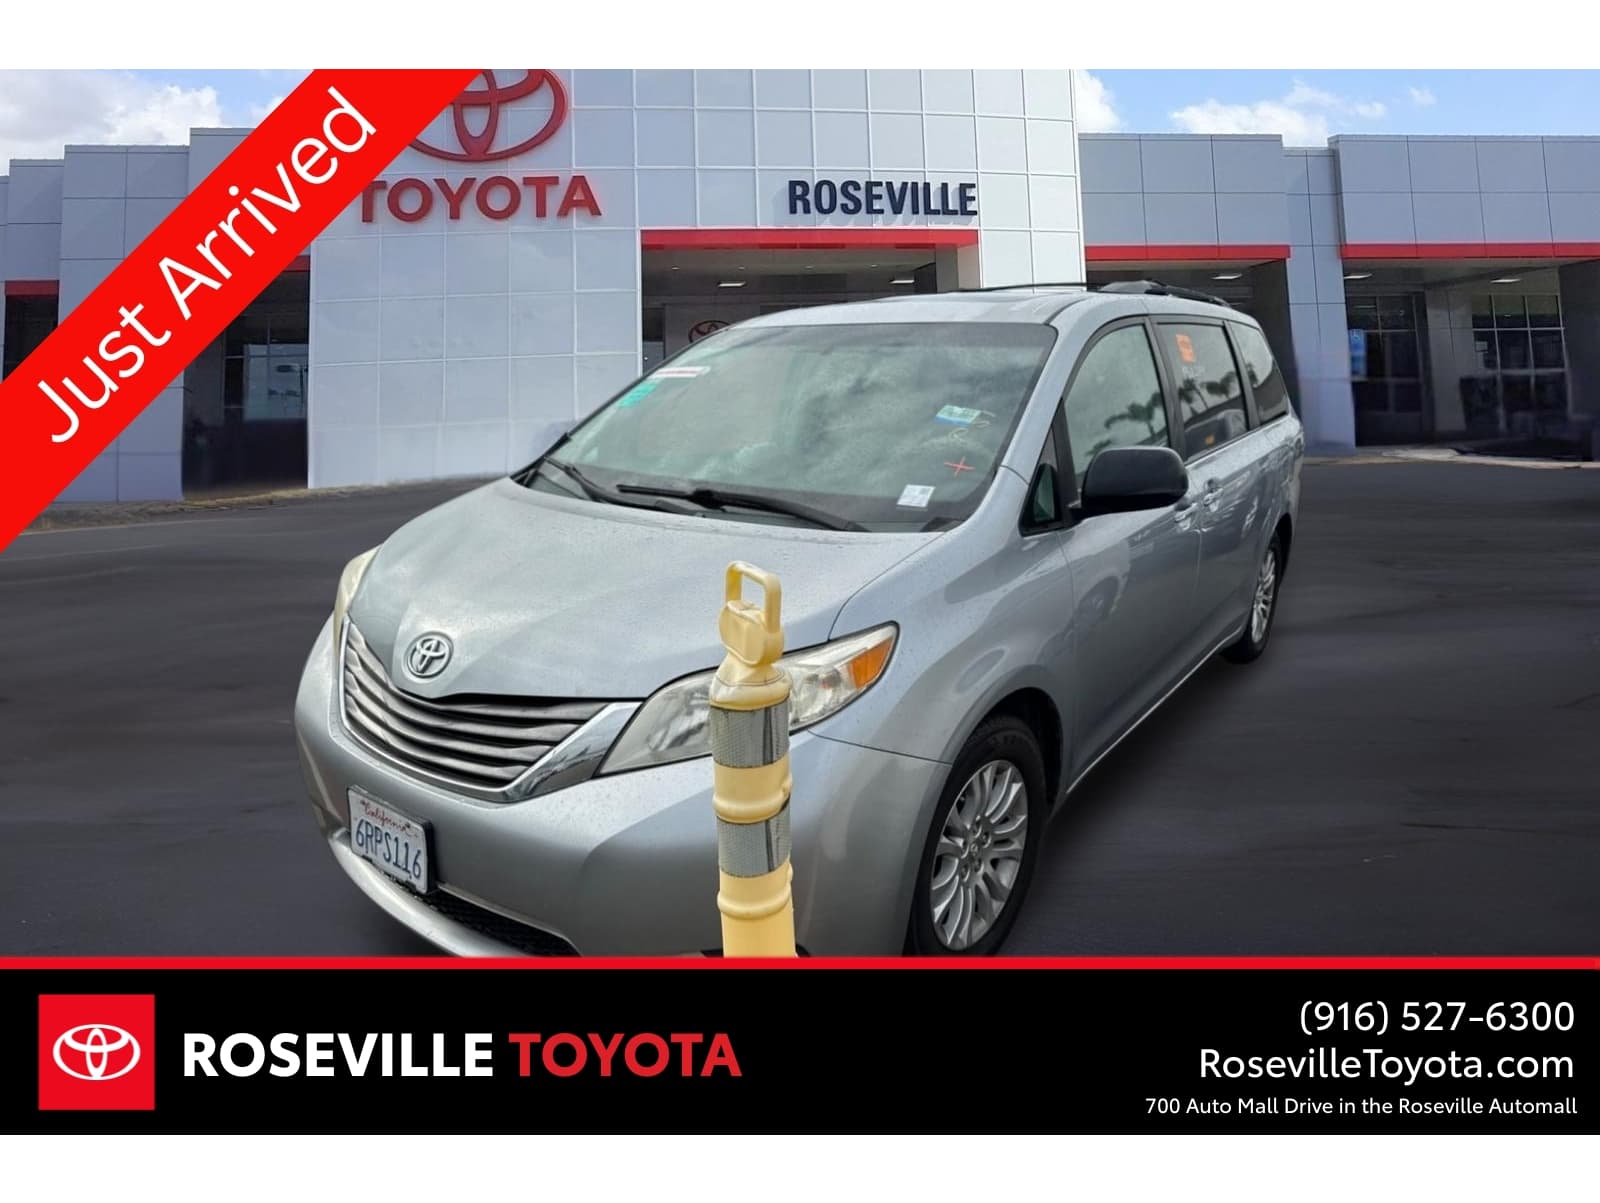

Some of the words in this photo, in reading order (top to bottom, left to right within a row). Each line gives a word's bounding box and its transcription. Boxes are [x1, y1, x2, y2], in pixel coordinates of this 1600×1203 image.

[361, 175, 602, 222] TOYOTA
[788, 180, 978, 215] ROSEVILLE
[356, 819, 421, 879] 6RPS116
